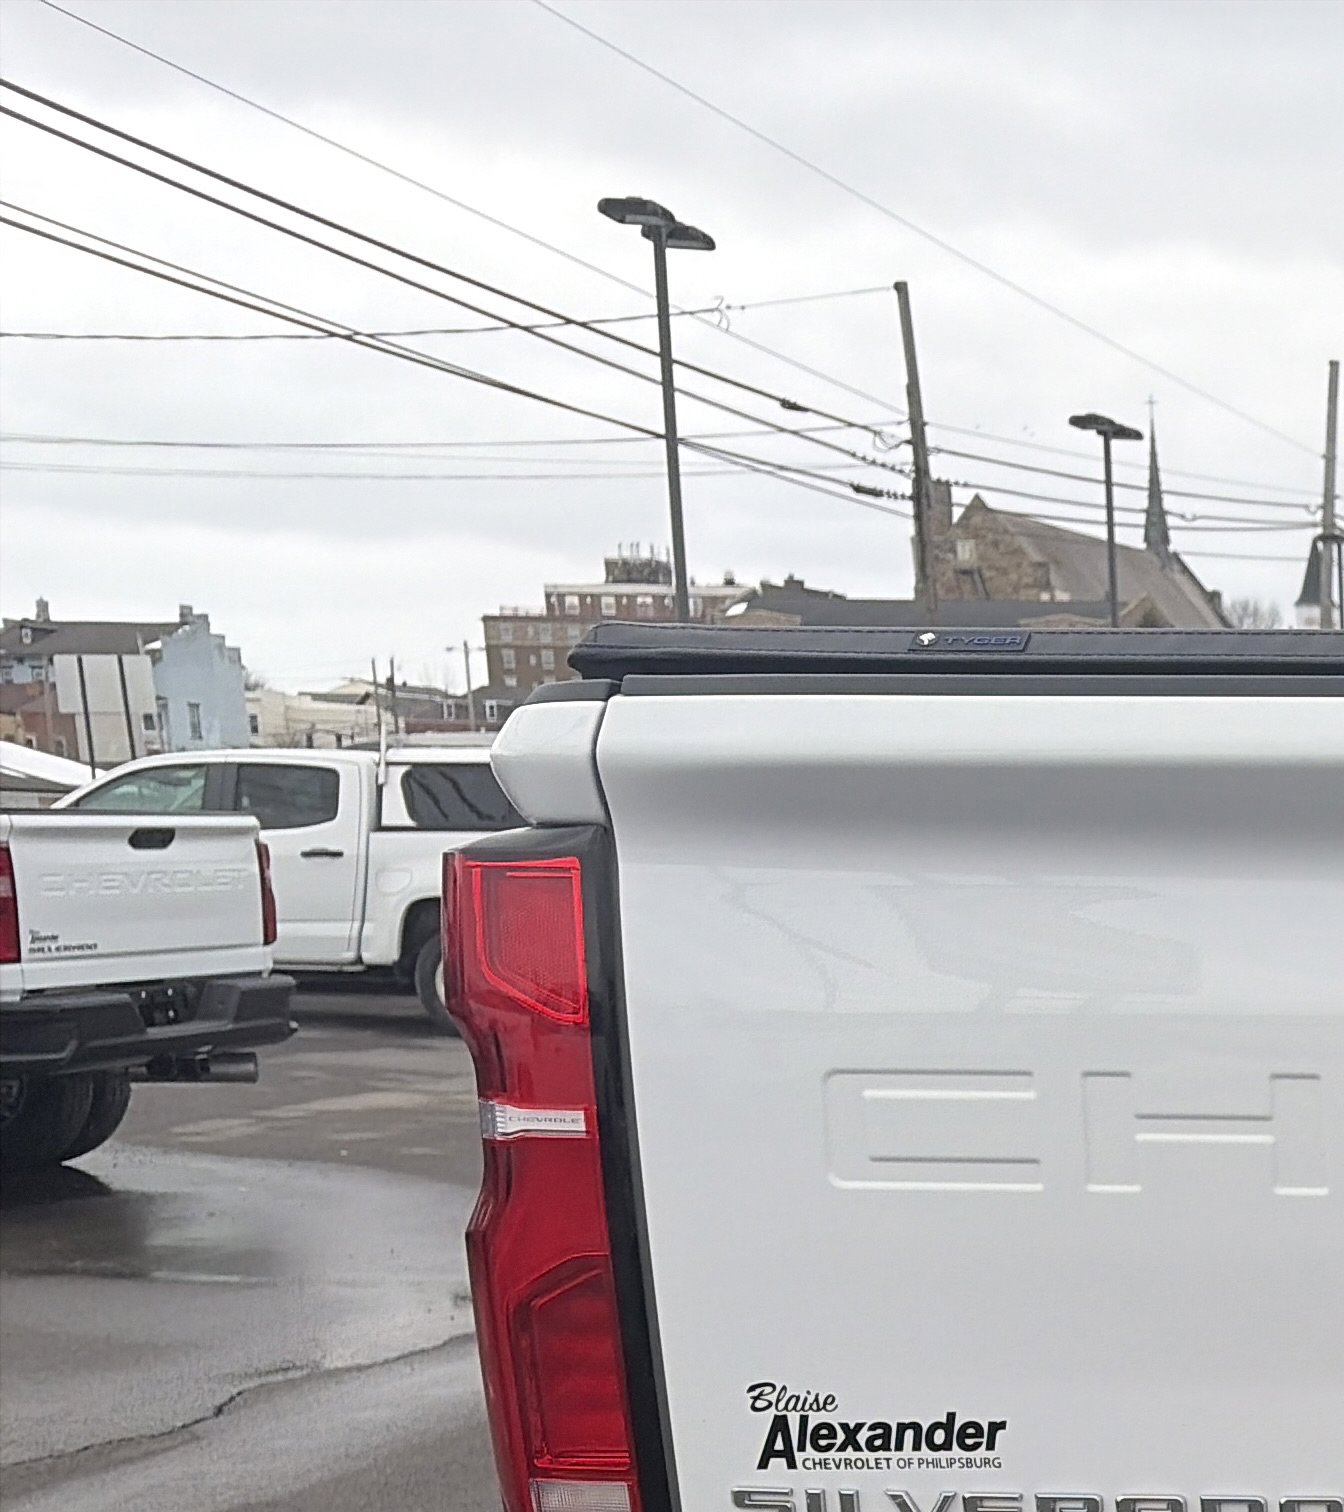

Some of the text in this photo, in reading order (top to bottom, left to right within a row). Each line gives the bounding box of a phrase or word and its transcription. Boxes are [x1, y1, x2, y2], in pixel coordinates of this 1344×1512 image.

[944, 636, 1021, 645] TYGER
[42, 868, 248, 896] CHEVROLET
[746, 1382, 838, 1412] Blaise
[756, 1412, 1007, 1470] Alexander
[802, 1457, 1002, 1470] CHEVROLET OF PHILIPSBURG
